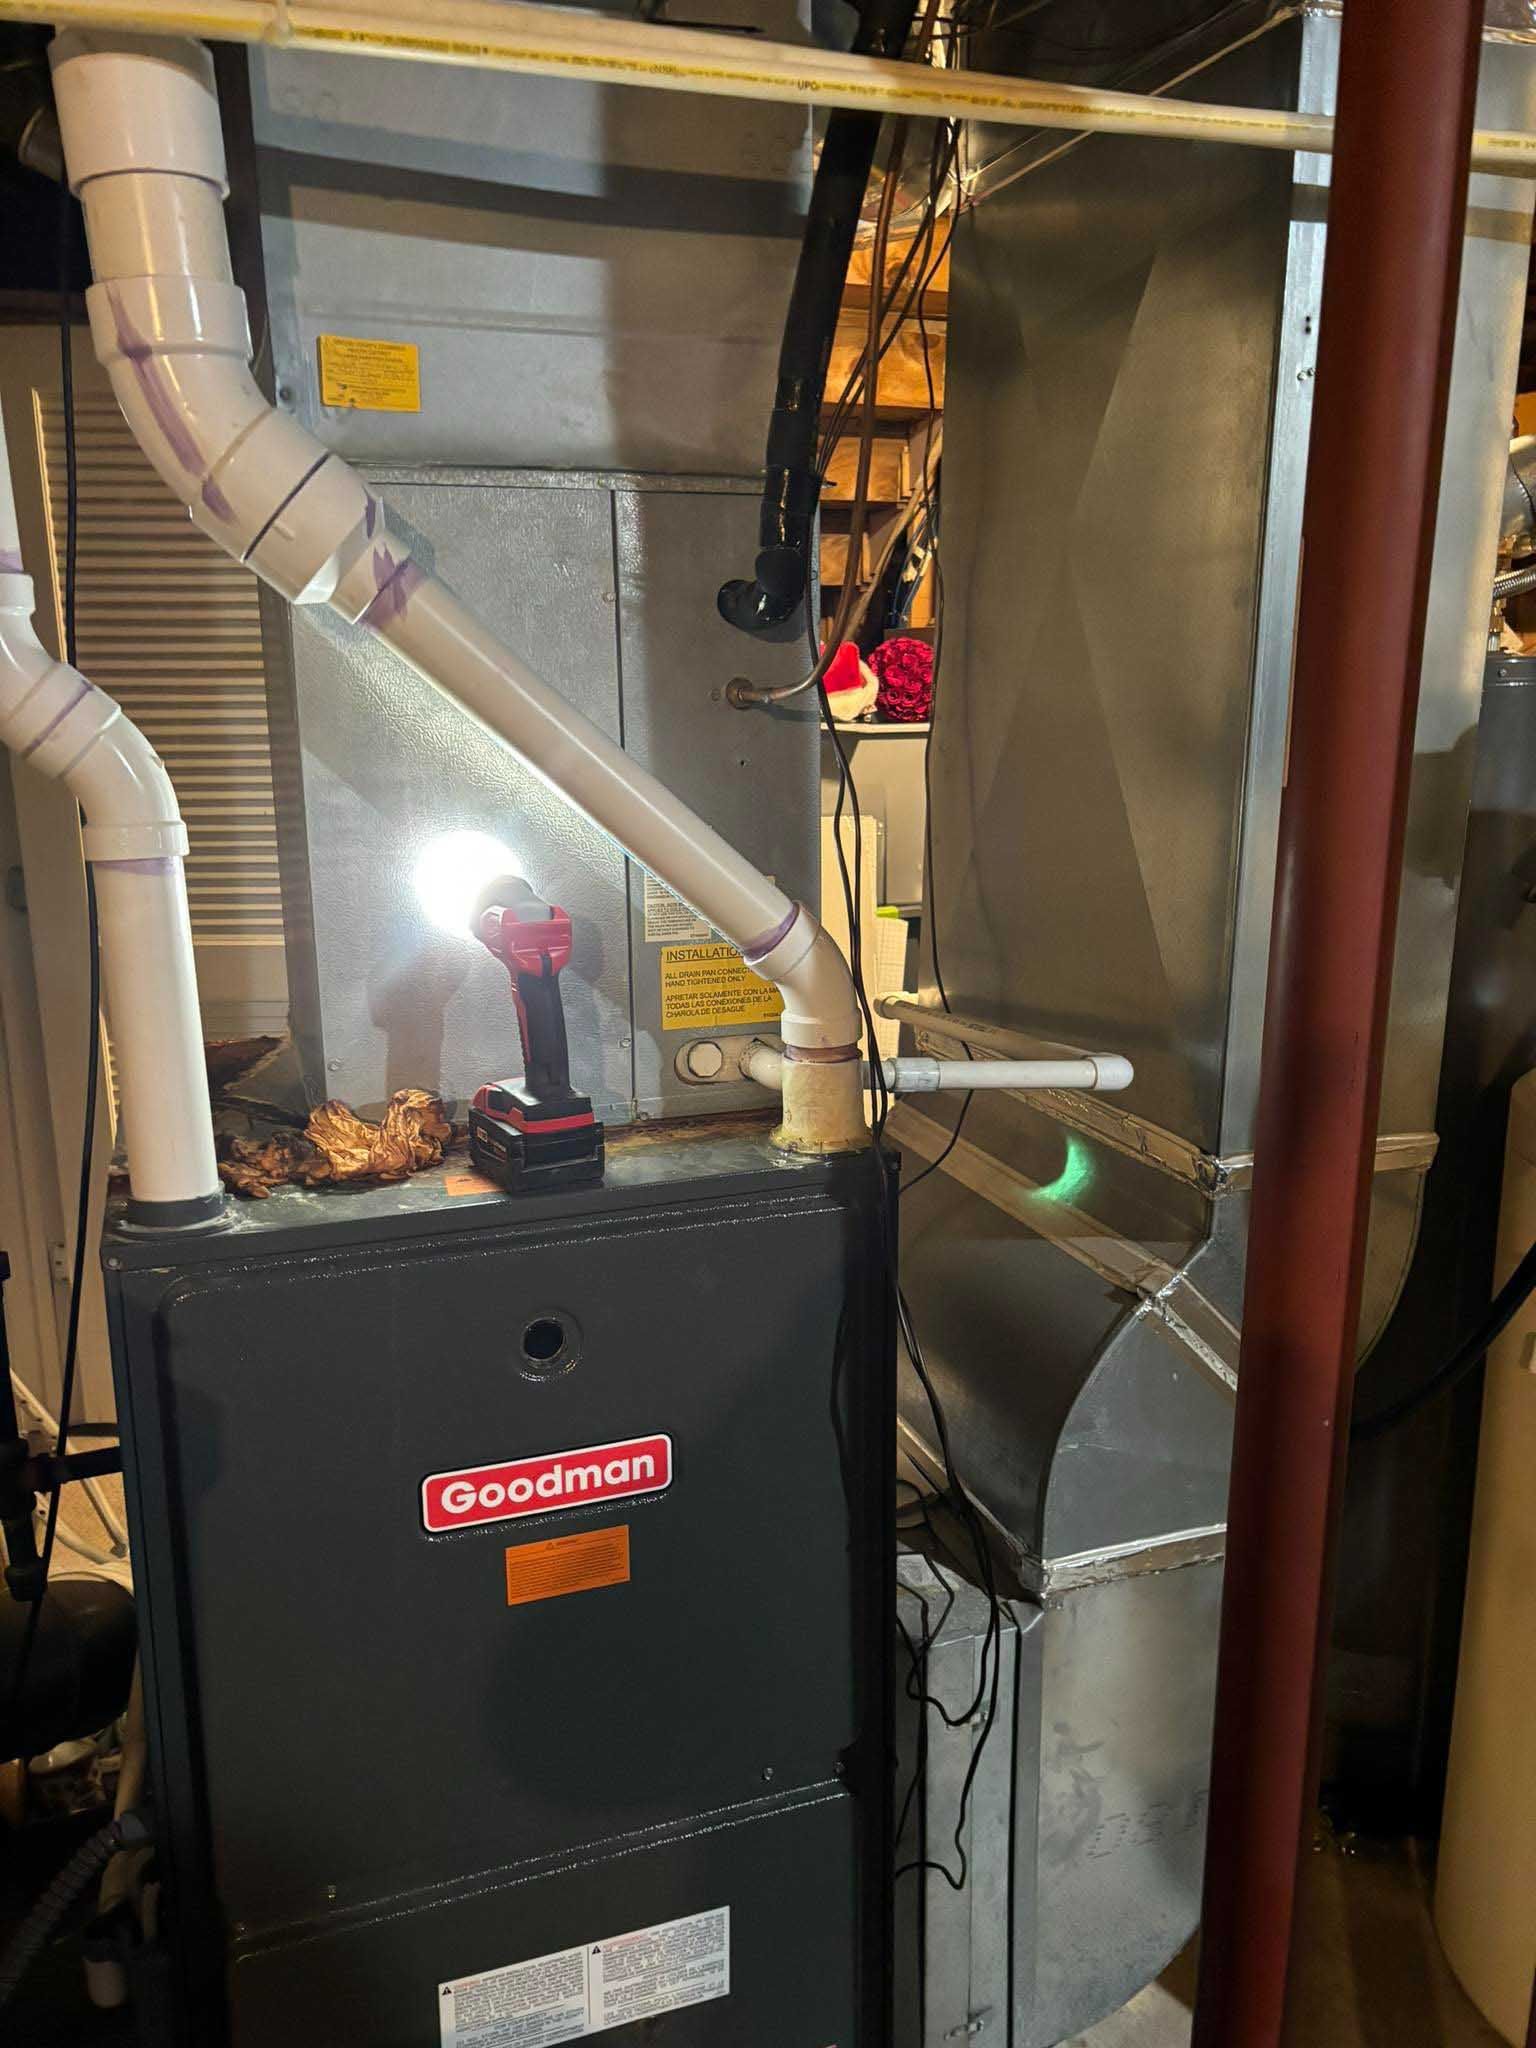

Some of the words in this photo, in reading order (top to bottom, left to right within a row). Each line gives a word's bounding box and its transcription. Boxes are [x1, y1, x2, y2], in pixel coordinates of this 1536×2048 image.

[665, 972, 678, 980] ALL
[679, 970, 701, 979] DRAIN
[702, 969, 717, 978] PAN
[665, 979, 686, 988] HAND
[687, 976, 727, 986] TIGHTENED
[665, 993, 699, 1002] APRETAR
[700, 990, 741, 999] SOLAMENTE
[743, 988, 758, 996] CON
[760, 987, 769, 995] LA
[666, 1001, 690, 1010] TODAS
[691, 1000, 705, 1009] LAS
[706, 997, 751, 1007] CONEXIONES
[665, 1008, 700, 1018] CHAROLA
[441, 1454, 655, 1514] Goodman
